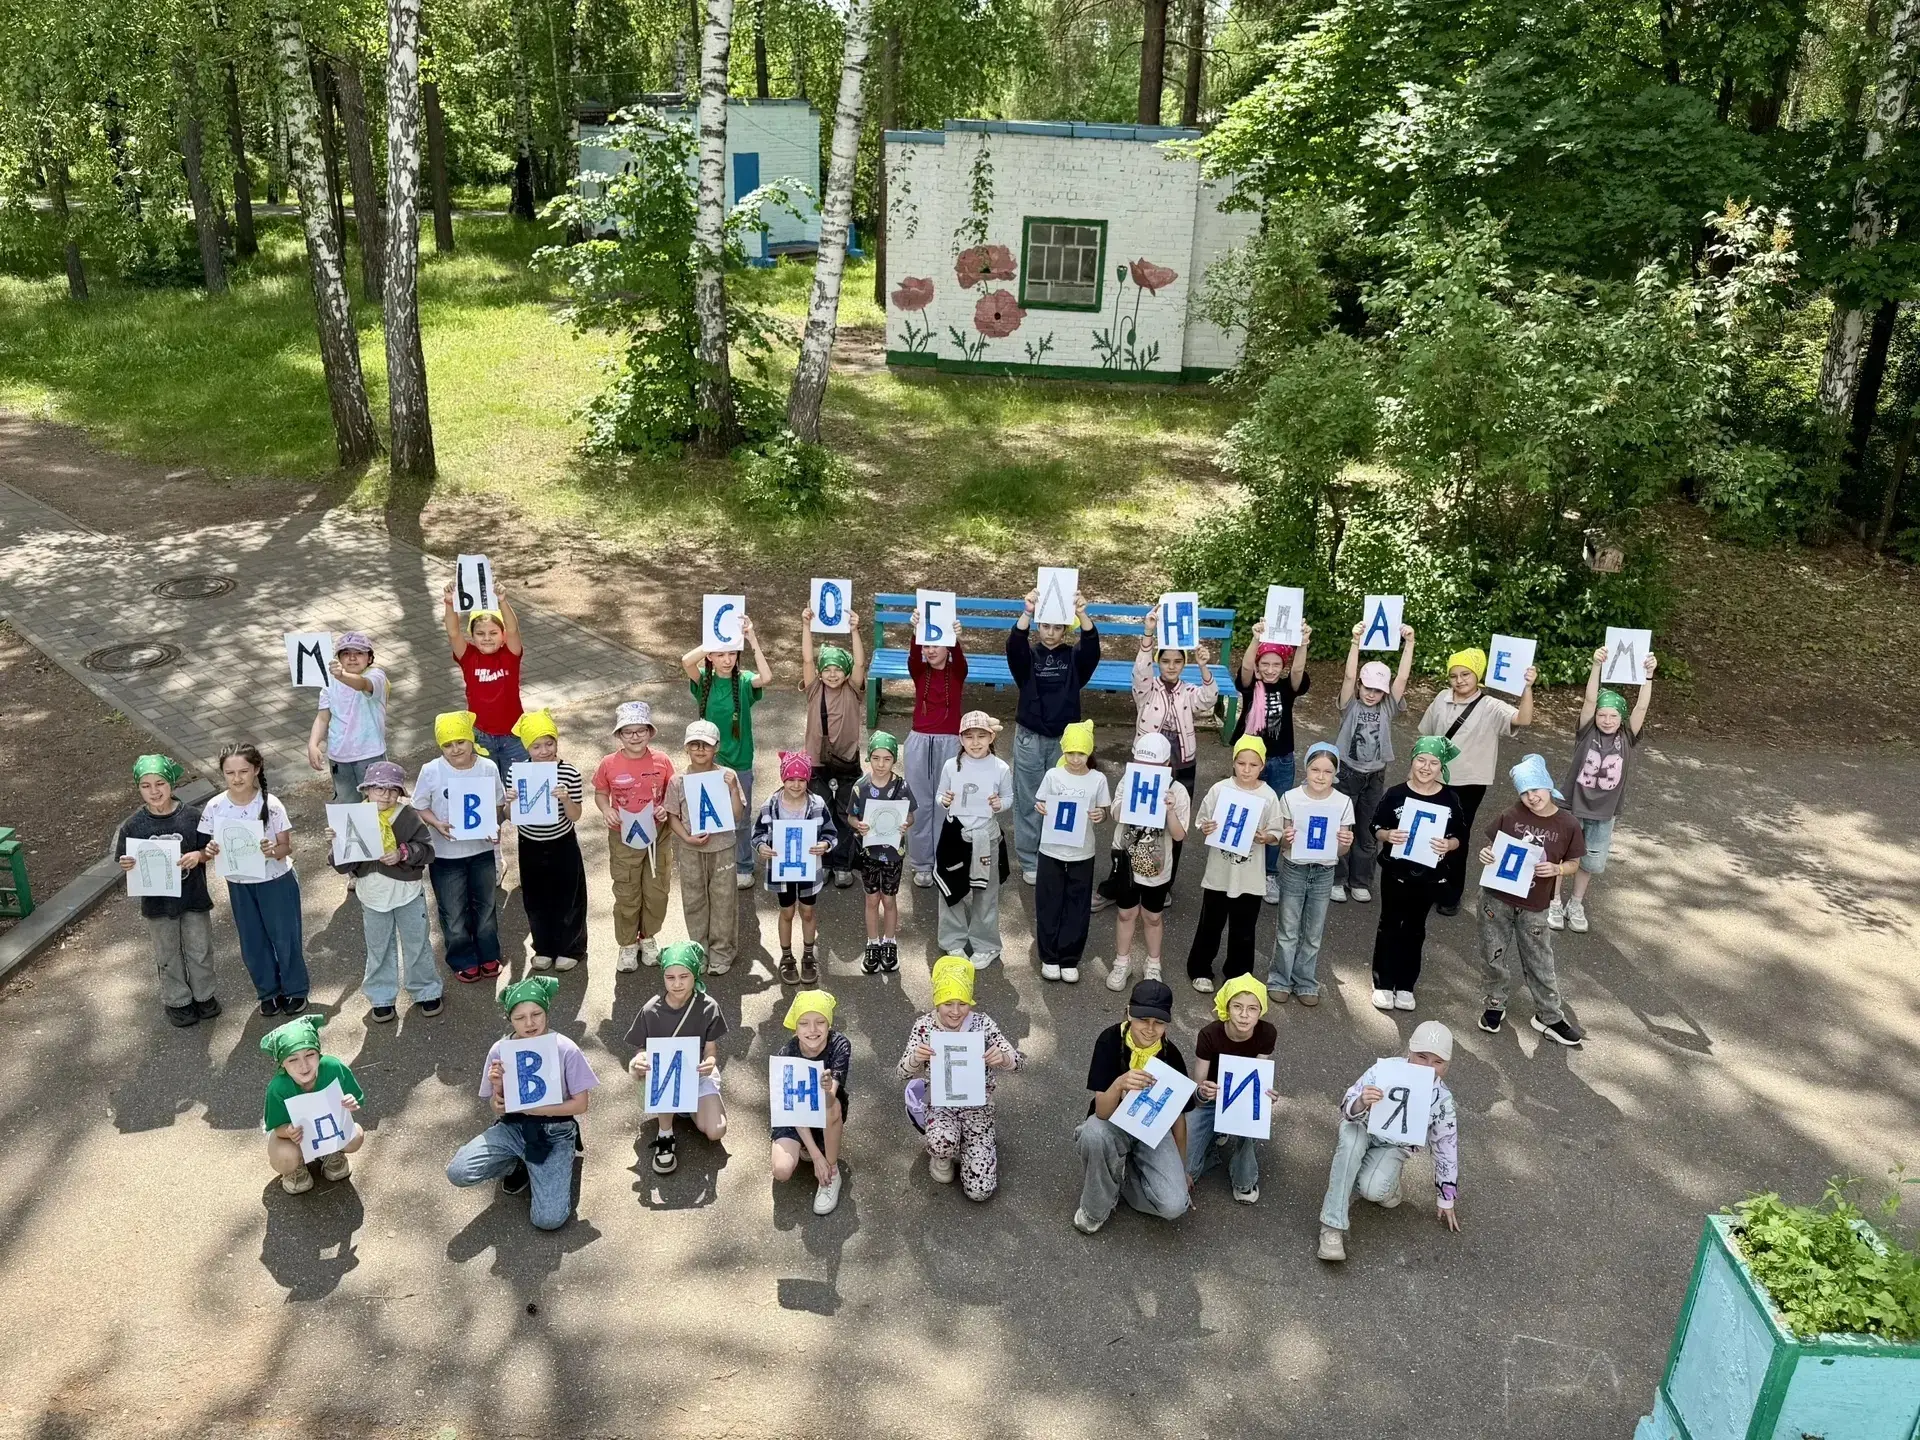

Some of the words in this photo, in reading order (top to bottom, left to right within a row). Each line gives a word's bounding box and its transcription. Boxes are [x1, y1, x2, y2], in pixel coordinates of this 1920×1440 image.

[458, 563, 488, 610] Ы
[819, 582, 842, 626] О
[1038, 572, 1067, 621] Л
[713, 604, 734, 642] С
[925, 601, 943, 641] Б
[1163, 602, 1193, 646] Ю
[1269, 605, 1292, 641] Д
[1364, 601, 1389, 647] А
[297, 641, 329, 687] М
[1493, 650, 1512, 682] Е
[1607, 639, 1637, 681] М
[464, 794, 480, 829] В
[518, 778, 550, 814] И
[700, 783, 723, 830] А
[962, 783, 979, 808] Р
[1130, 771, 1160, 814] Ж
[344, 813, 372, 859] А
[627, 820, 649, 844] Л
[872, 808, 903, 836] О
[1054, 801, 1077, 832] О
[1220, 803, 1248, 847] Н
[1307, 816, 1327, 850] О
[1404, 810, 1436, 855] Г
[1513, 821, 1559, 843] KAWAII
[138, 848, 172, 889] П
[223, 827, 259, 871] Р
[779, 827, 806, 876] Д
[1496, 844, 1528, 881] О
[516, 1051, 546, 1104] В
[650, 1050, 682, 1107] И
[784, 1064, 819, 1111] Ж
[944, 1045, 968, 1100] Е
[1223, 1069, 1260, 1120] И
[1127, 1079, 1173, 1127] Н
[1381, 1087, 1410, 1134] Я
[312, 1113, 344, 1150] Д
